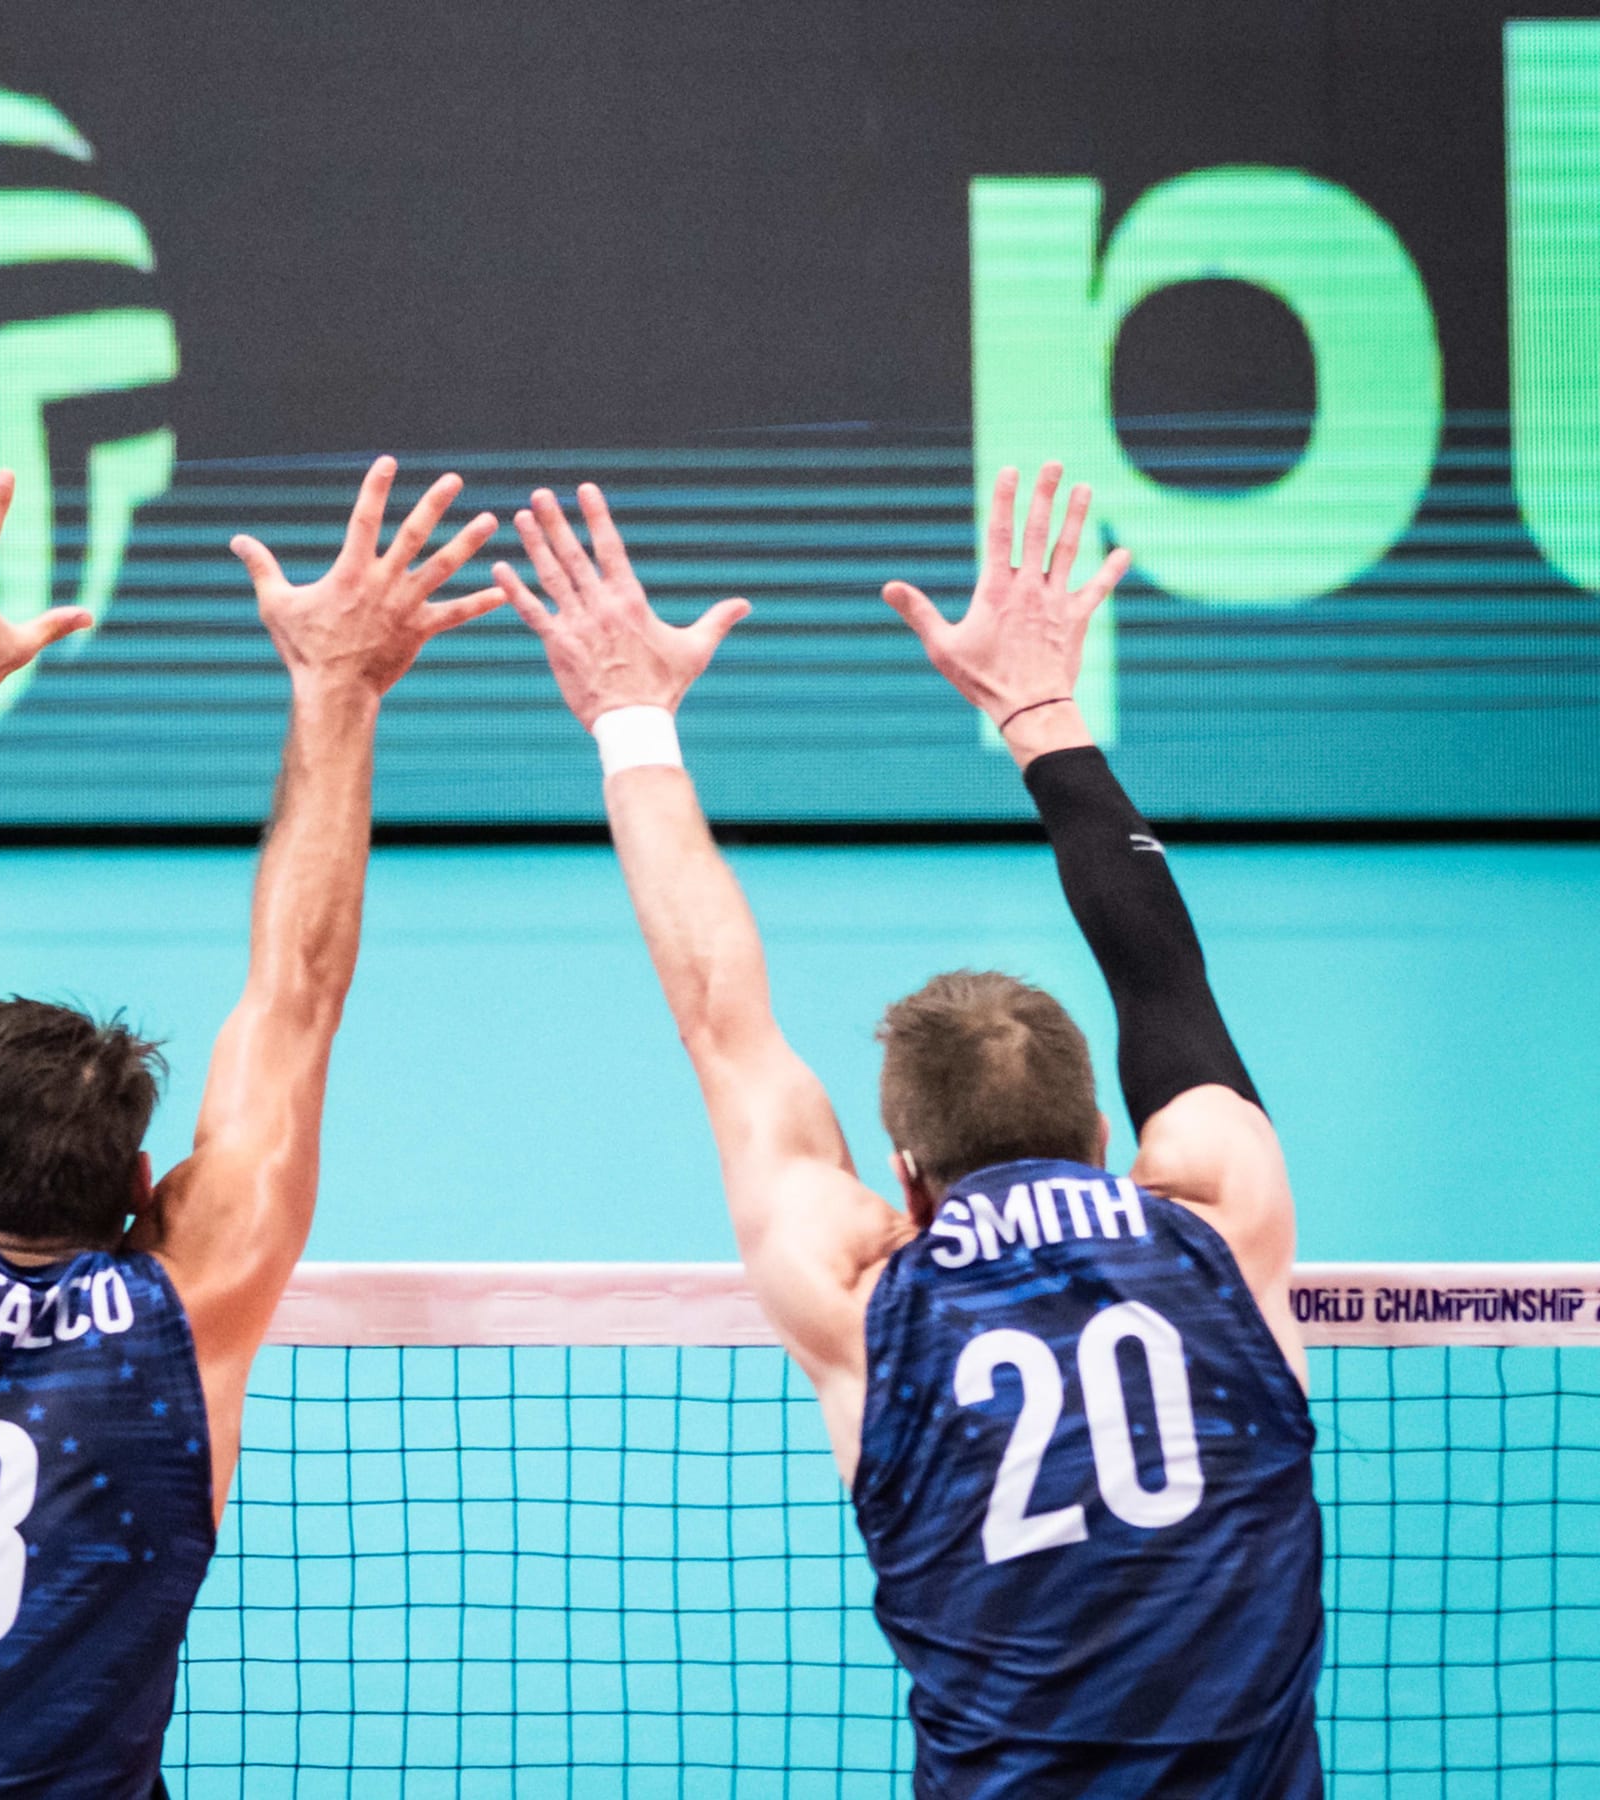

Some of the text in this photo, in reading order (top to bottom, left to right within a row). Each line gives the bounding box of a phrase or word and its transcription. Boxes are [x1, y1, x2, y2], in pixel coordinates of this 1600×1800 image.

[930, 1177, 1148, 1269] SMITH
[1374, 1286, 1585, 1323] CHAMPIONSHIP
[953, 1300, 1205, 1565] 20
